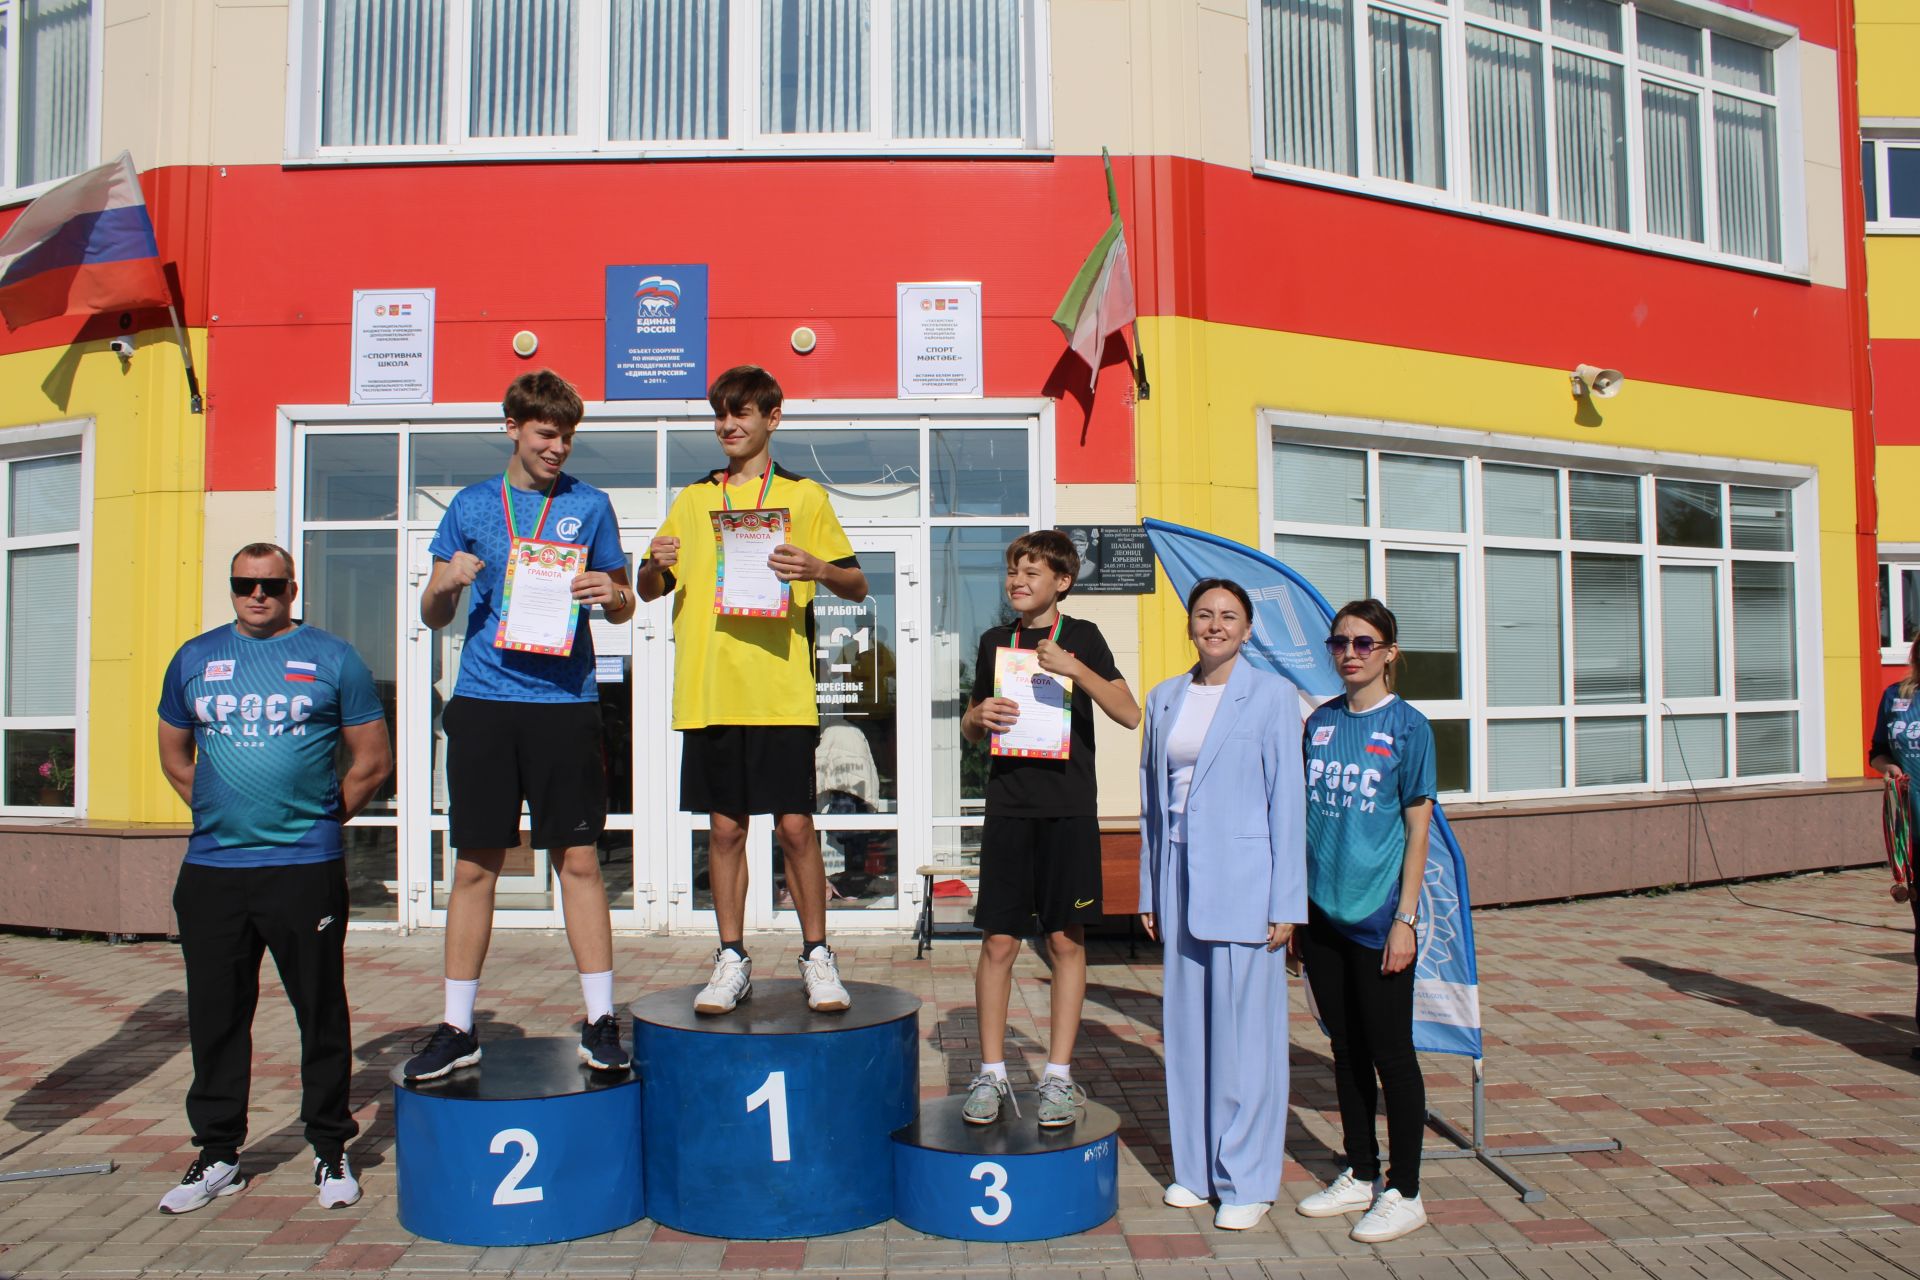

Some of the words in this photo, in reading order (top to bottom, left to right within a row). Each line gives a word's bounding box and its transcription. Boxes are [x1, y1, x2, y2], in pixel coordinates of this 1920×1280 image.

[637, 318, 676, 326] ЕДИНАЯ
[527, 568, 562, 578] ГРАМОТА
[827, 606, 867, 616] РАБОТЫ
[1016, 676, 1051, 685] ГРАМОТА
[195, 693, 313, 722] КРОСС
[1307, 758, 1381, 797] РОСС
[1309, 789, 1375, 813] АЦИИ
[746, 1071, 791, 1162] 1
[489, 1128, 544, 1206] 2
[969, 1161, 1012, 1227] 3
